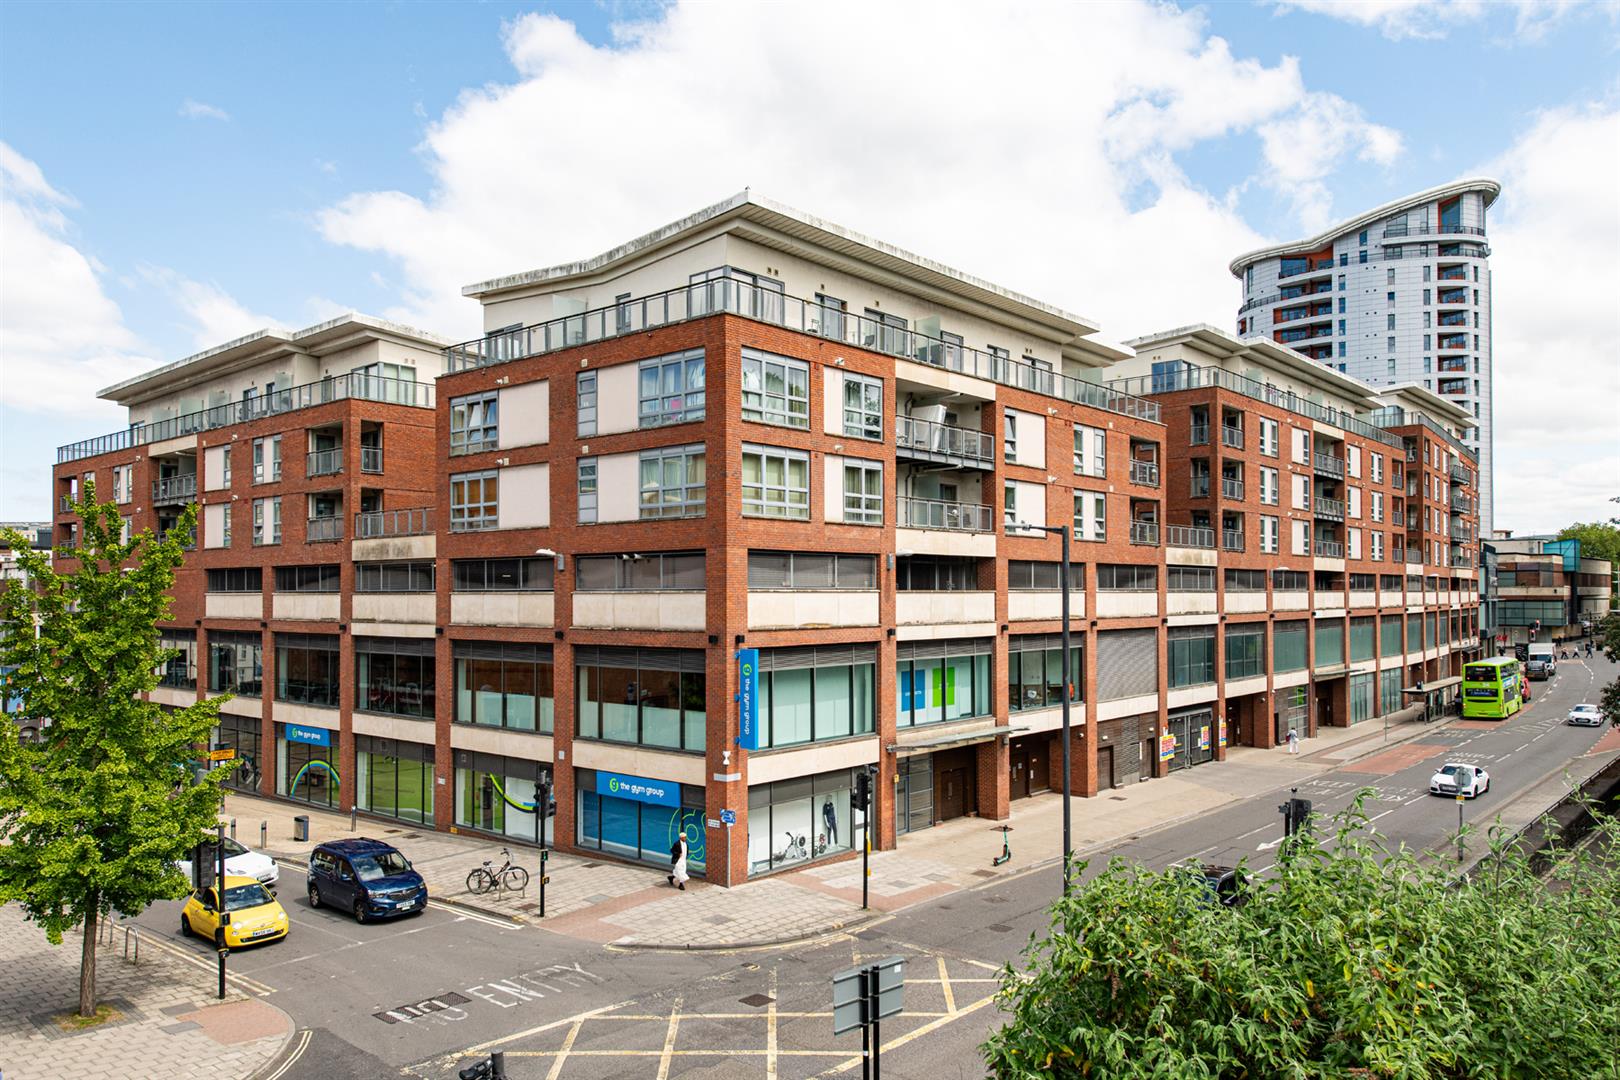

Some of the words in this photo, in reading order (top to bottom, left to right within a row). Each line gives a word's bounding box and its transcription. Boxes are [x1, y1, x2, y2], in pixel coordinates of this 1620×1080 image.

[620, 782, 630, 791] the
[631, 785, 645, 794] gym
[645, 787, 665, 798] group
[465, 962, 605, 1009] ENTRY
